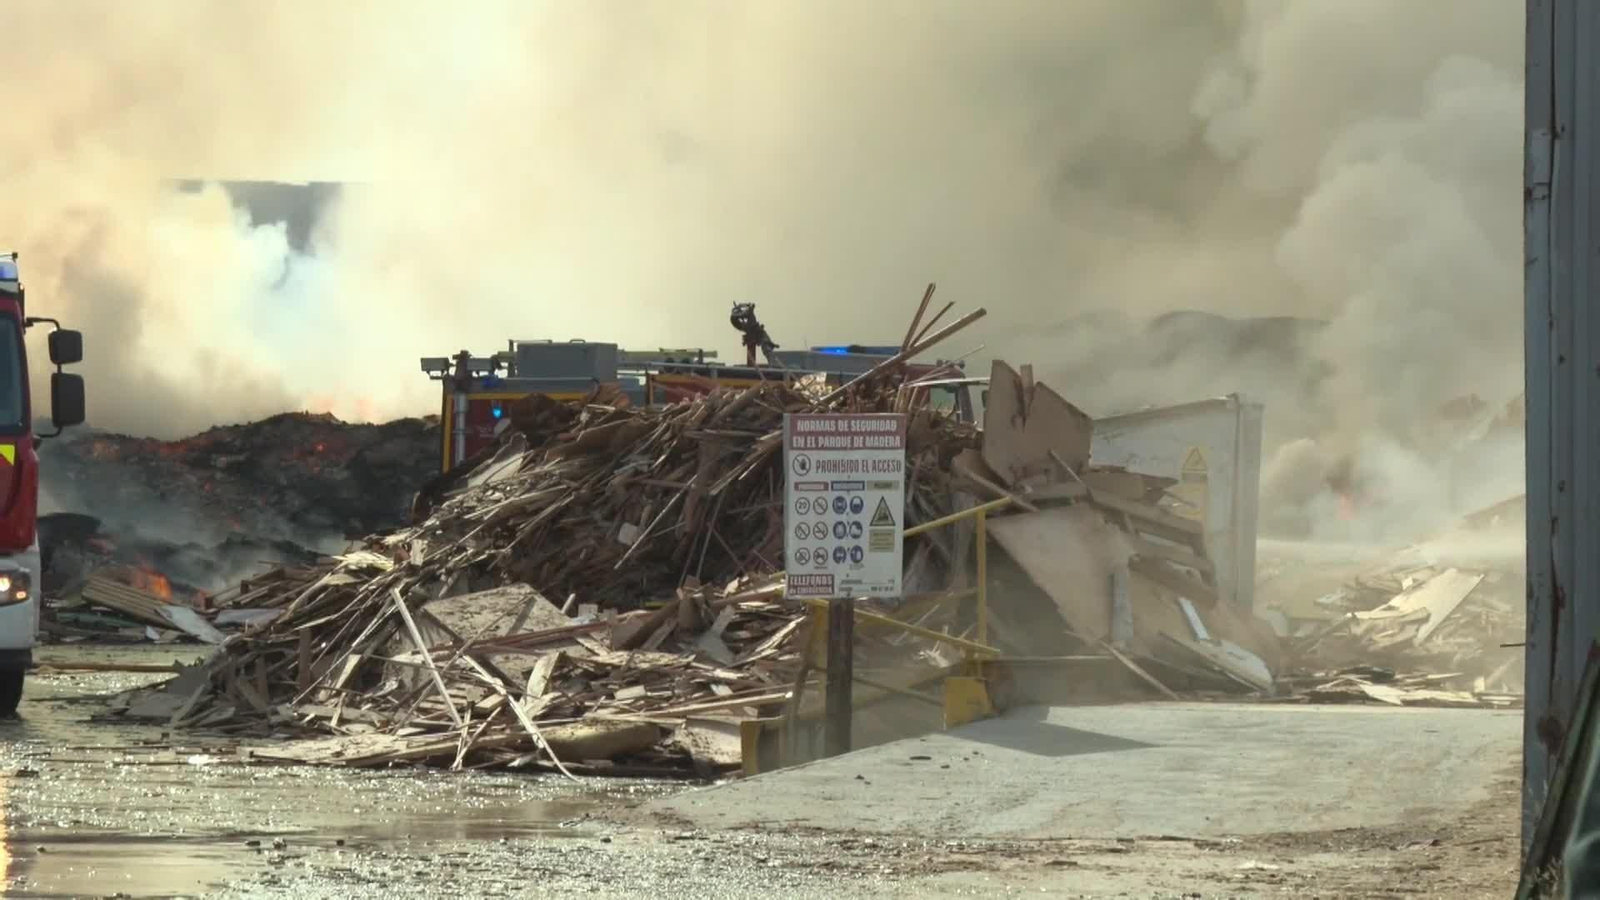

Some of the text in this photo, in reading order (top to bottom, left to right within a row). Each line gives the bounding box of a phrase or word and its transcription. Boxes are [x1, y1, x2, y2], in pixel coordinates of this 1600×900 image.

[797, 419, 897, 432] NORMAS DE SEGURIDAD
[792, 436, 901, 448] EN EL PARQUE DE MADERA
[816, 459, 902, 473] PROHIBIDO EL ACCESO
[789, 575, 833, 586] TELEFONOS
